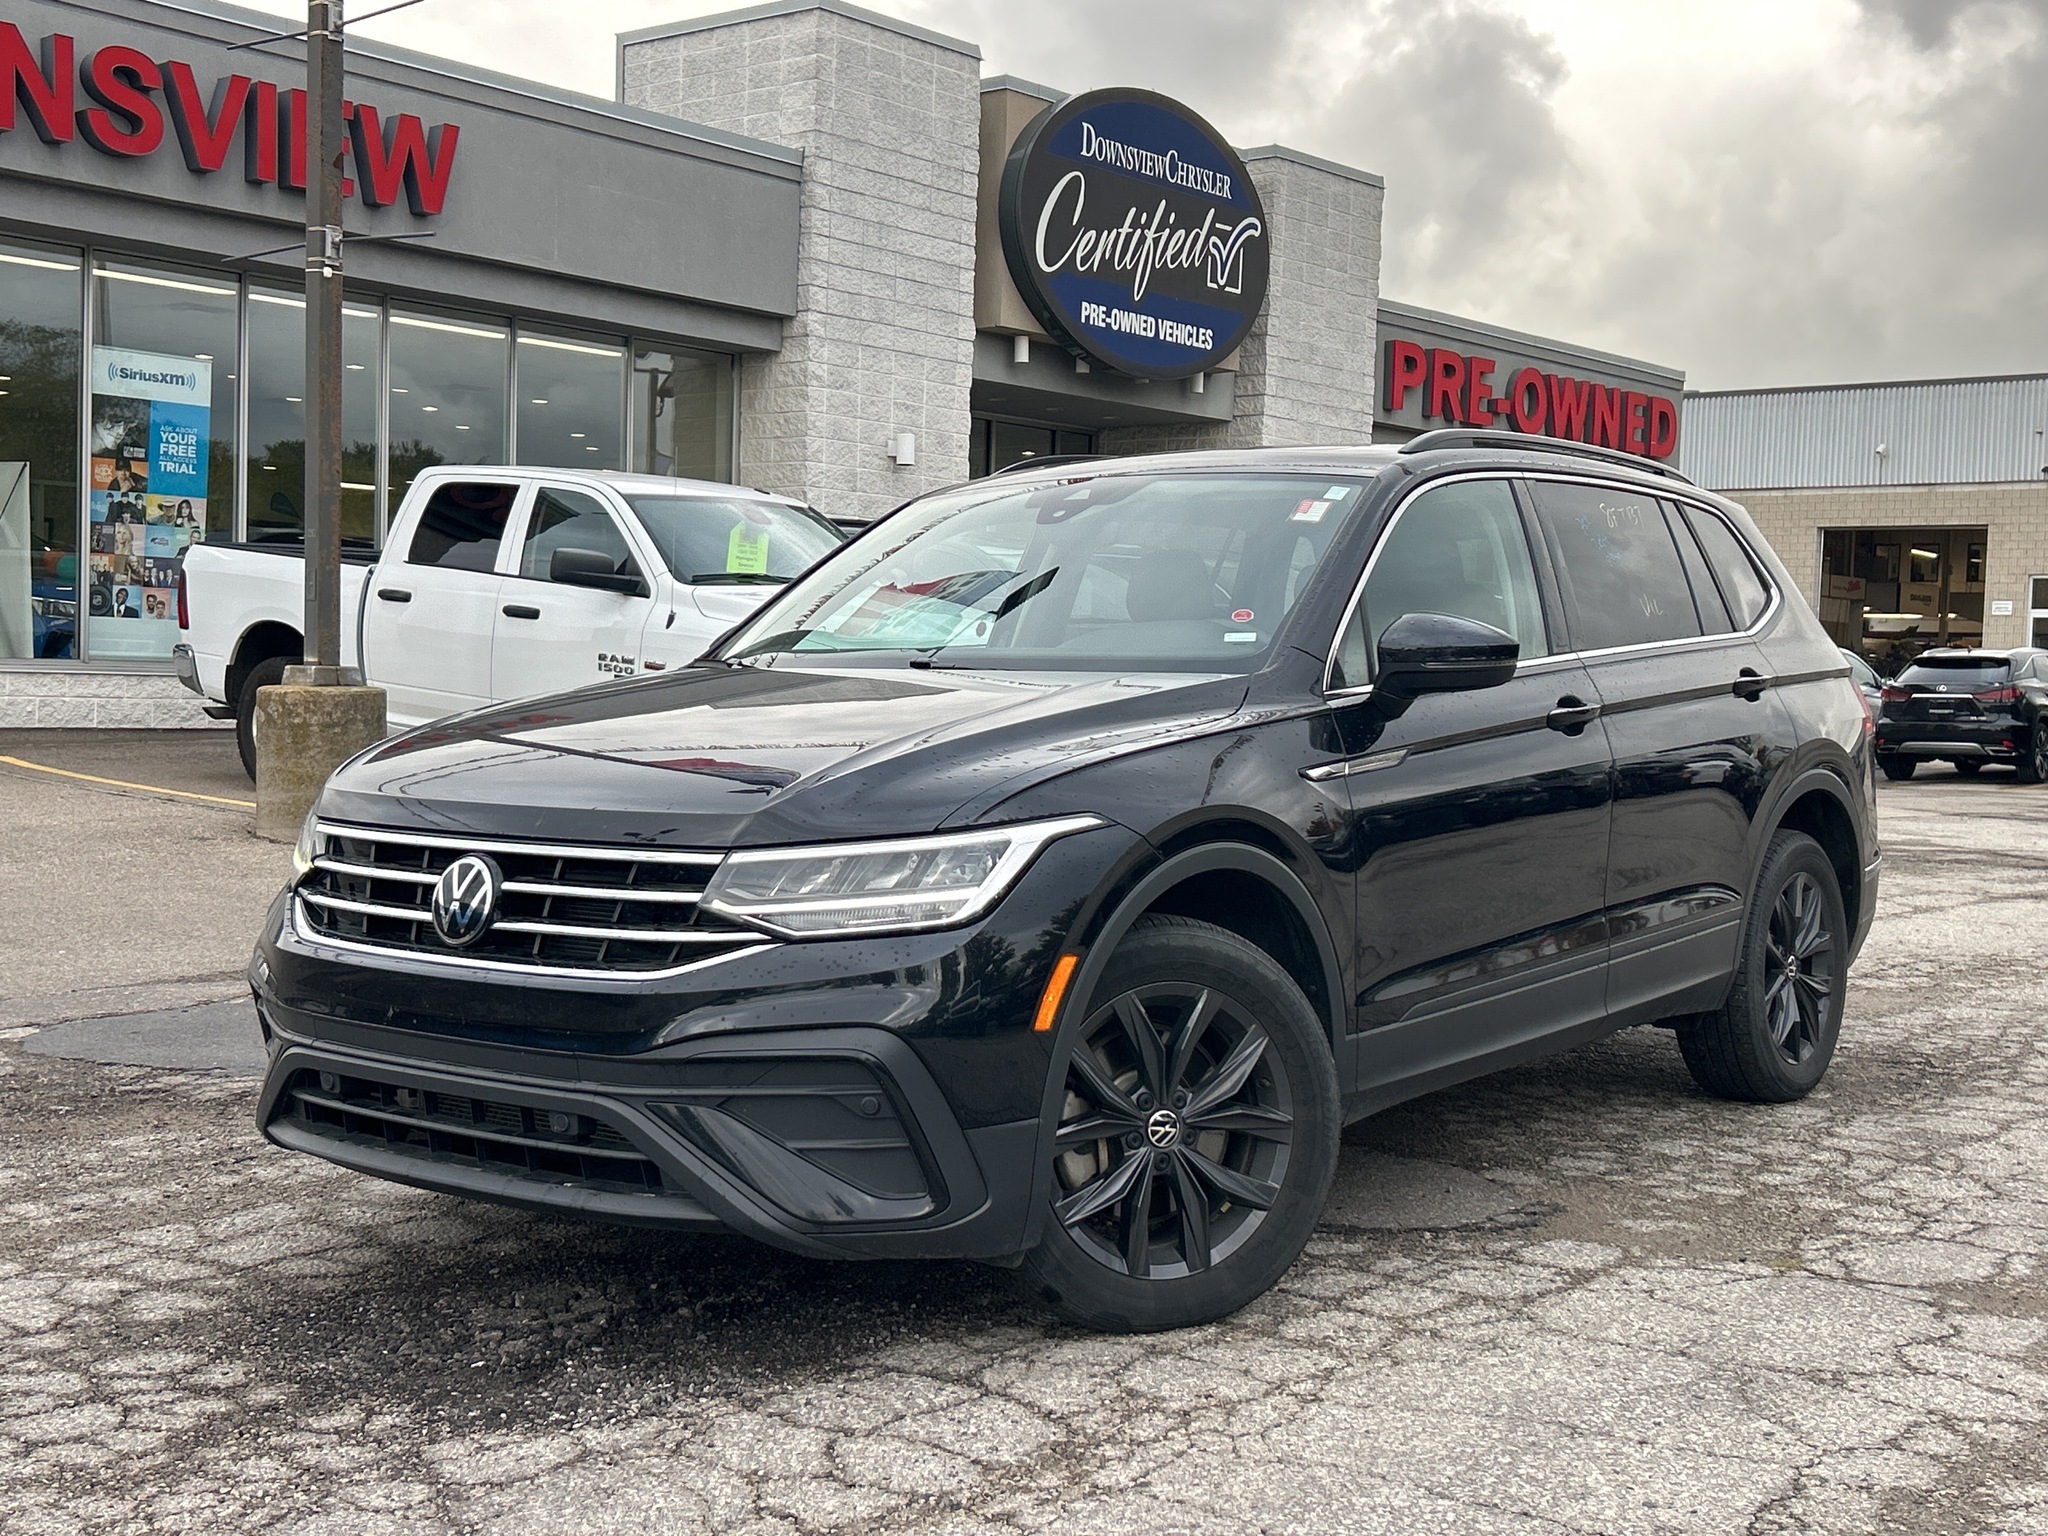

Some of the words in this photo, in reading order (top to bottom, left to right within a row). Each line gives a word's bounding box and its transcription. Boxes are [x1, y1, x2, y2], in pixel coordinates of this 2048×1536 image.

[1035, 170, 1216, 302] Certified
[1080, 301, 1156, 339] PRE-OWNED
[1157, 318, 1214, 351] VEHICLES
[1388, 339, 1678, 458] PRE-OWNED
[175, 426, 198, 434] ABOUT
[160, 431, 197, 446] YOUR
[159, 443, 197, 458] FREE
[172, 456, 197, 464] ACCESS
[158, 461, 197, 475] TRIAL
[597, 653, 636, 666] RAM
[597, 662, 636, 675] 1500
